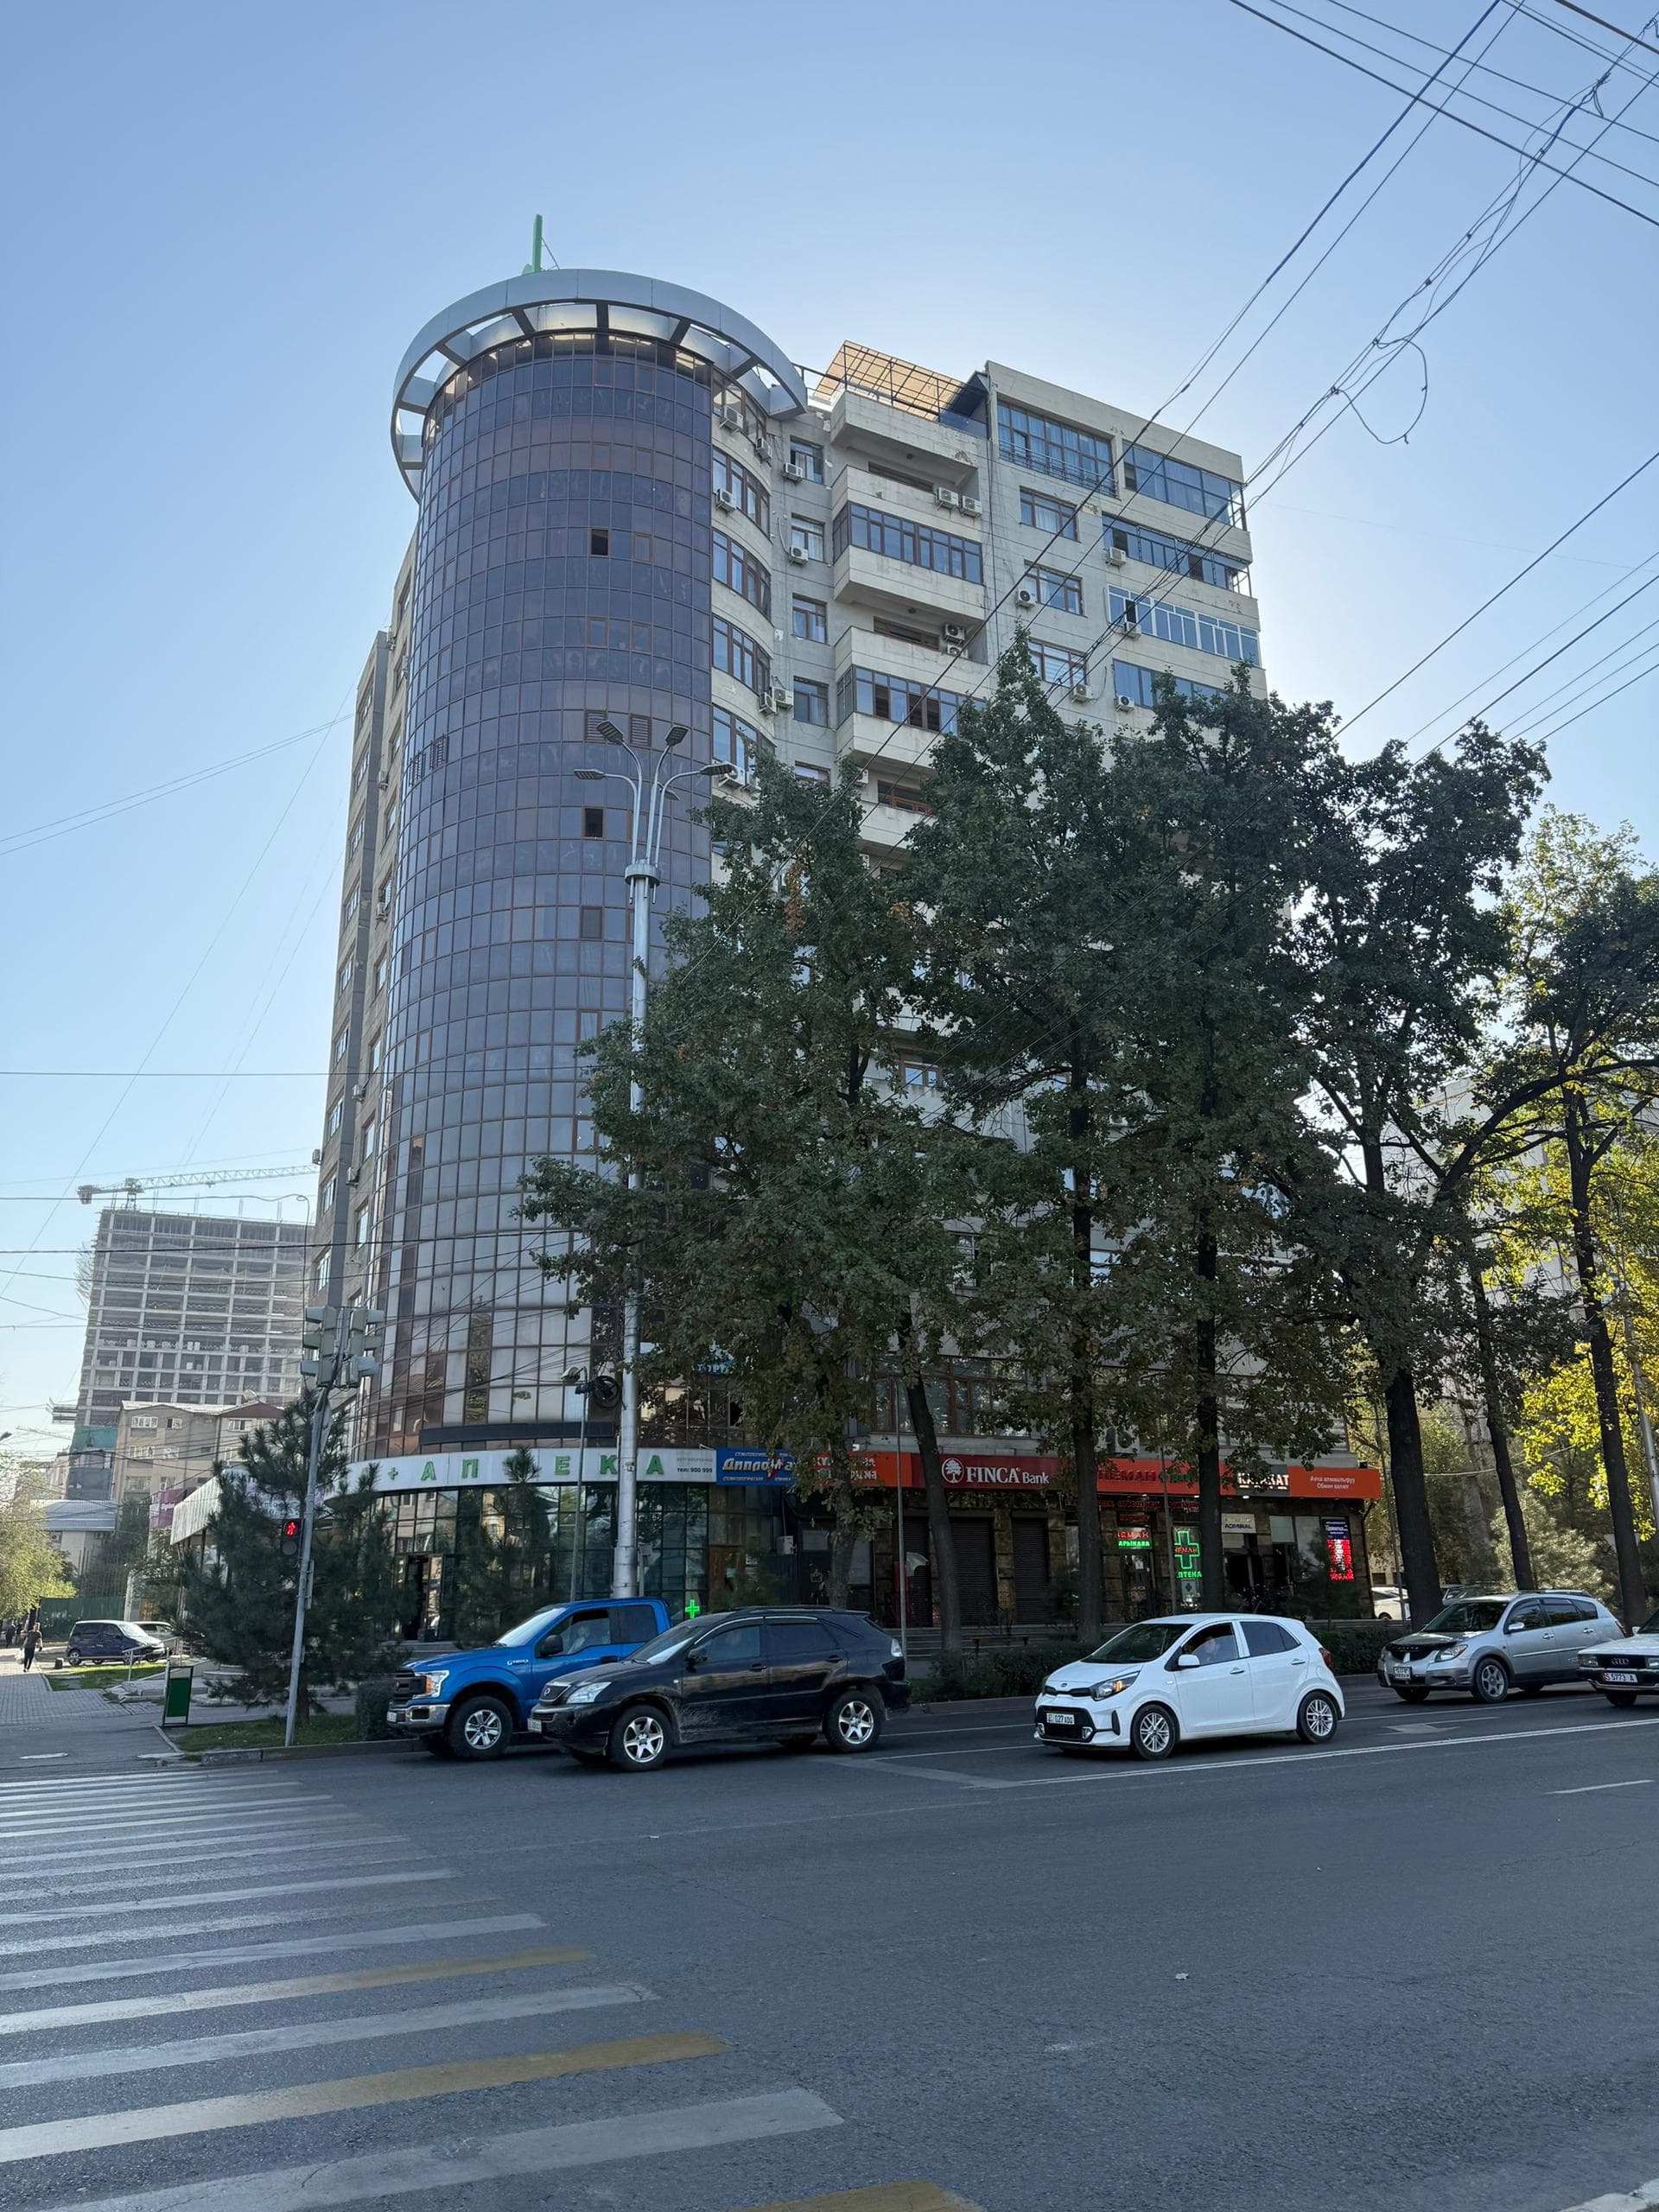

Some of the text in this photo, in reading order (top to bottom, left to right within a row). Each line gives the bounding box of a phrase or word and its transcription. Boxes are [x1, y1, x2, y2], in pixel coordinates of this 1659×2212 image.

[421, 1454, 664, 1480] АПЕКА
[965, 1466, 1049, 1484] FINCA Bank
